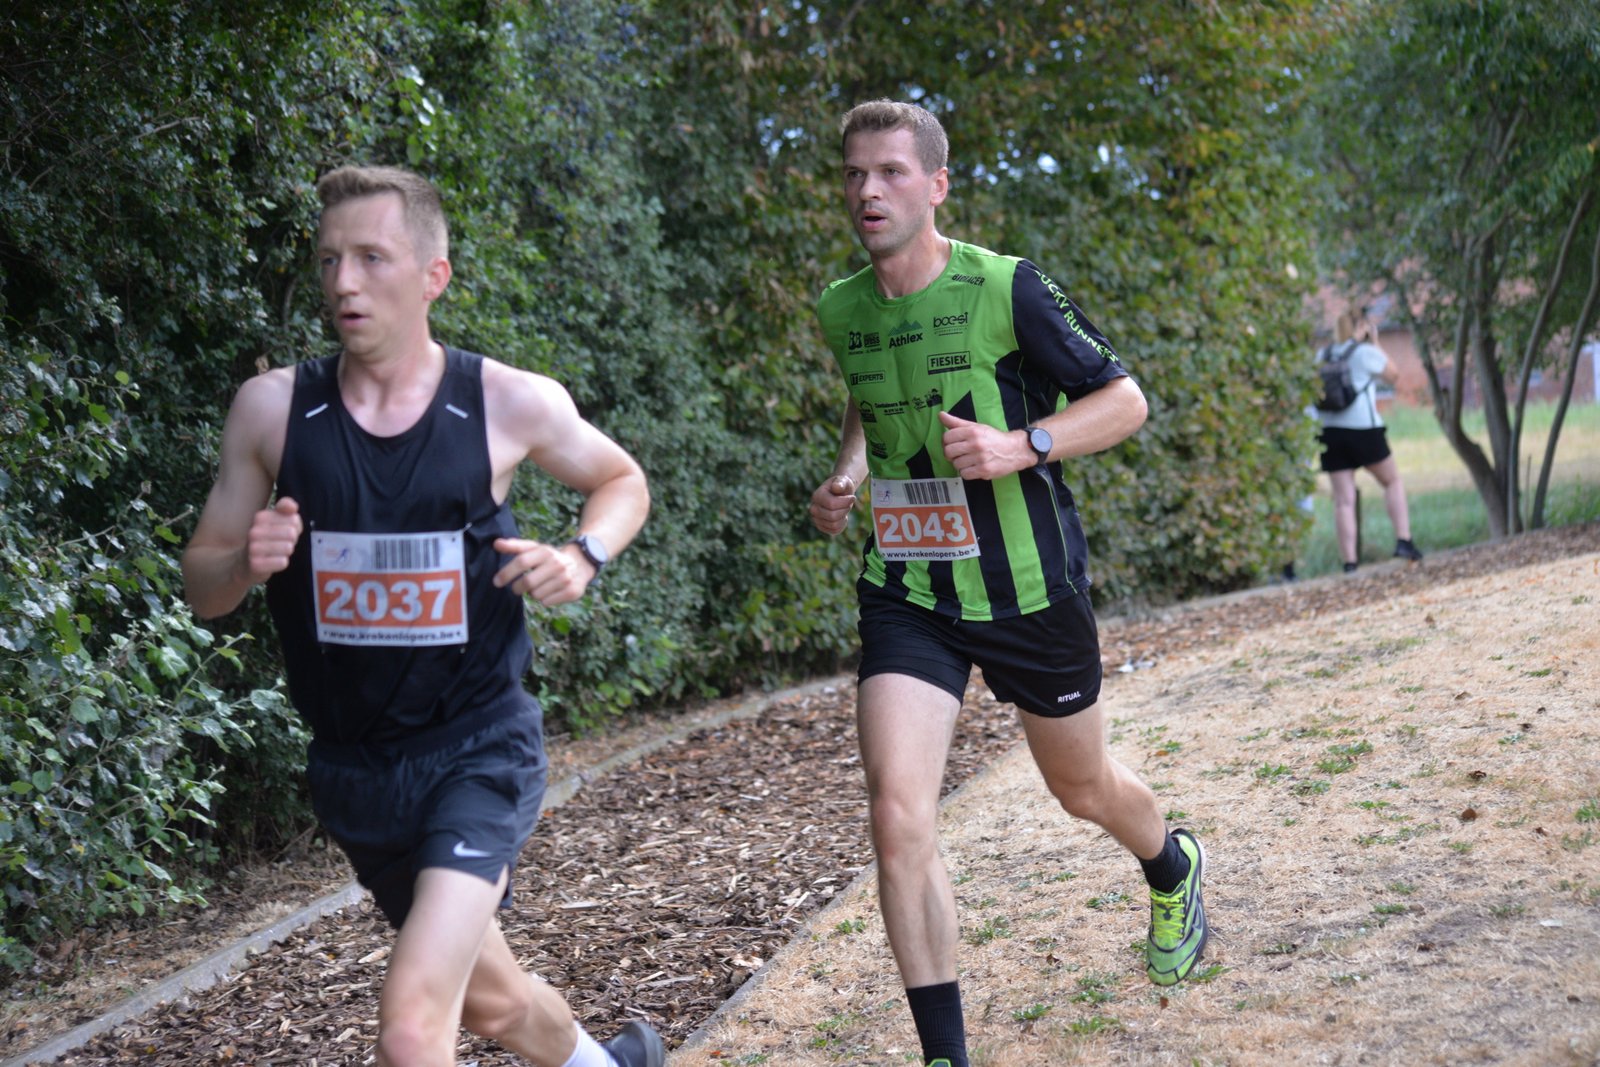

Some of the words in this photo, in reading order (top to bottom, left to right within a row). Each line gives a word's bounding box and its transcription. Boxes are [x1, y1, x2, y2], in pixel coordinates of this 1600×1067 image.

[889, 333, 924, 349] Athlex
[931, 355, 967, 368] FIESIEK
[859, 373, 884, 382] EXPERTS
[880, 512, 967, 543] 2043
[887, 549, 970, 558] www.krekenlopers.be
[323, 579, 454, 622] 2037
[1057, 691, 1081, 703] RITUAL
